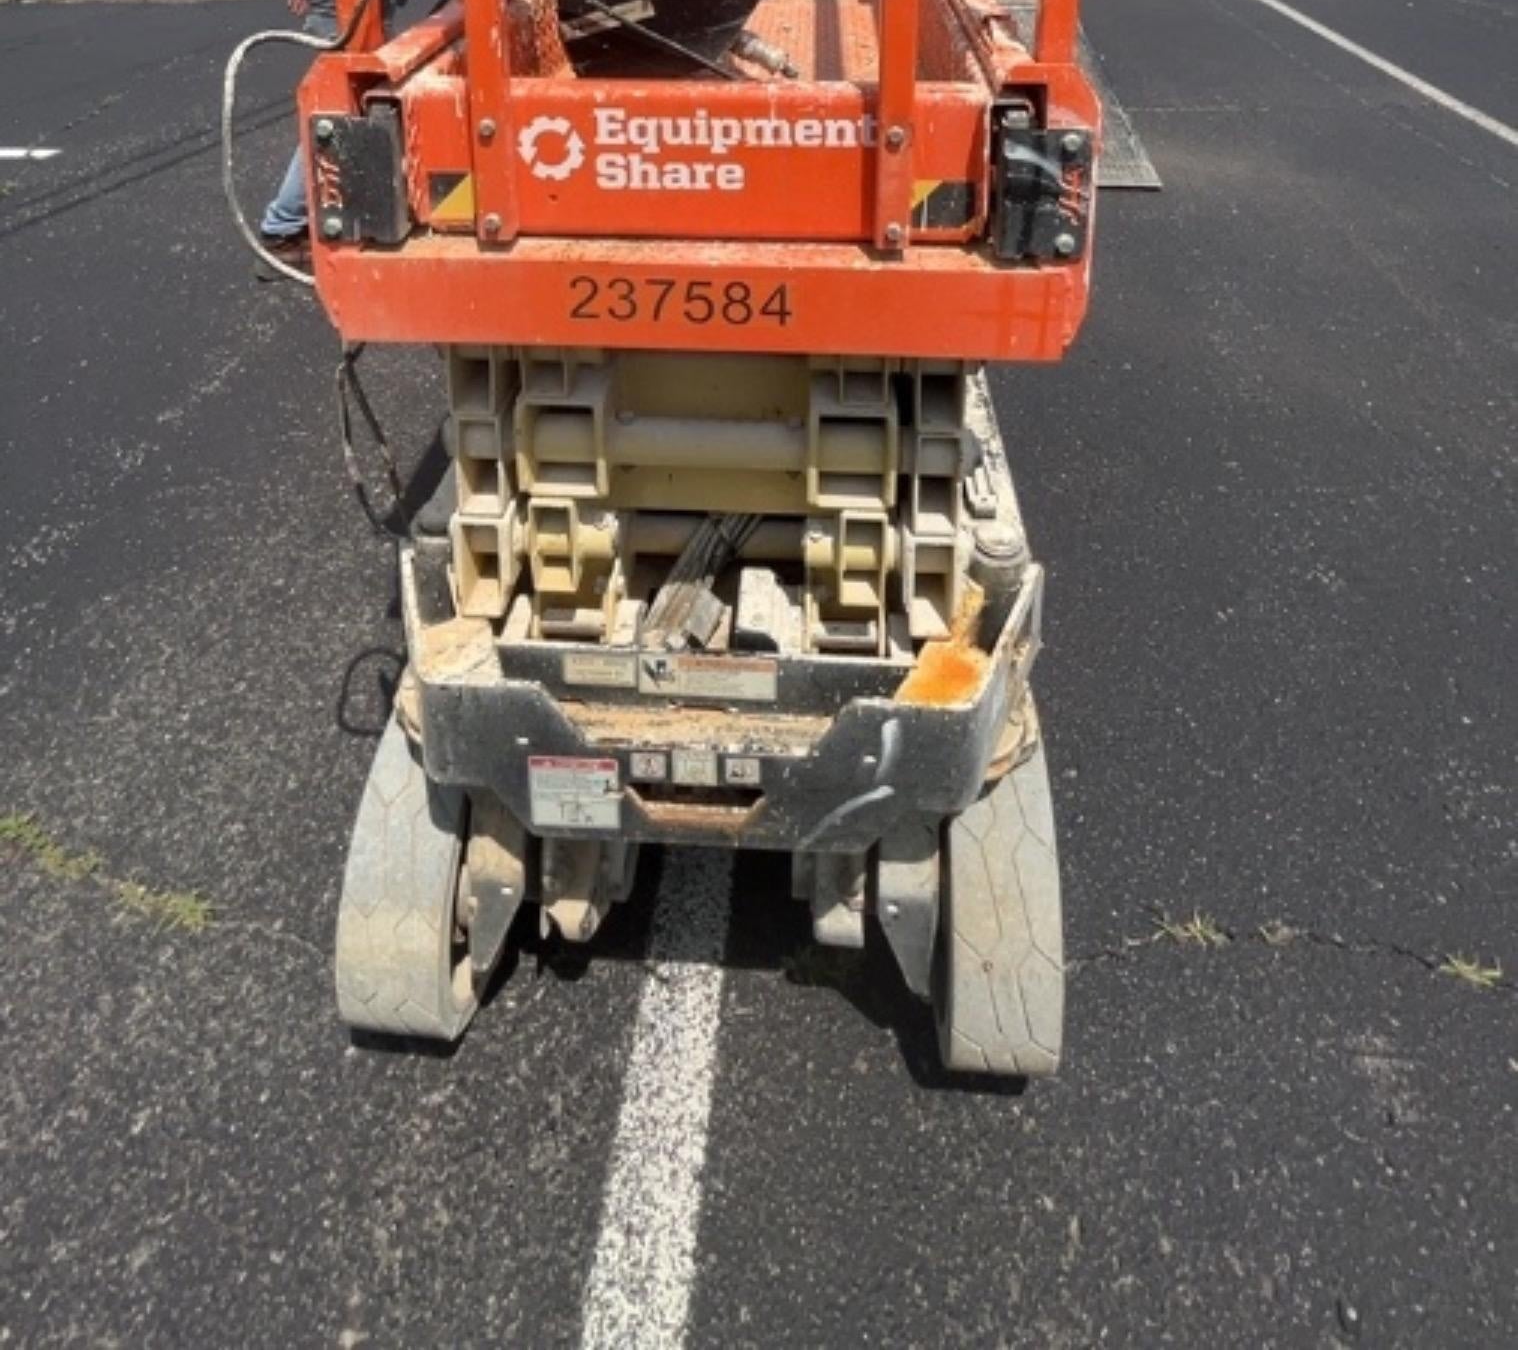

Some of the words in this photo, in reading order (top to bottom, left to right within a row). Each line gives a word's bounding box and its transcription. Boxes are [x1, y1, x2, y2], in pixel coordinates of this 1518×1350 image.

[593, 106, 879, 153] Equipment
[595, 152, 745, 190] Share
[568, 275, 793, 327] 237584
